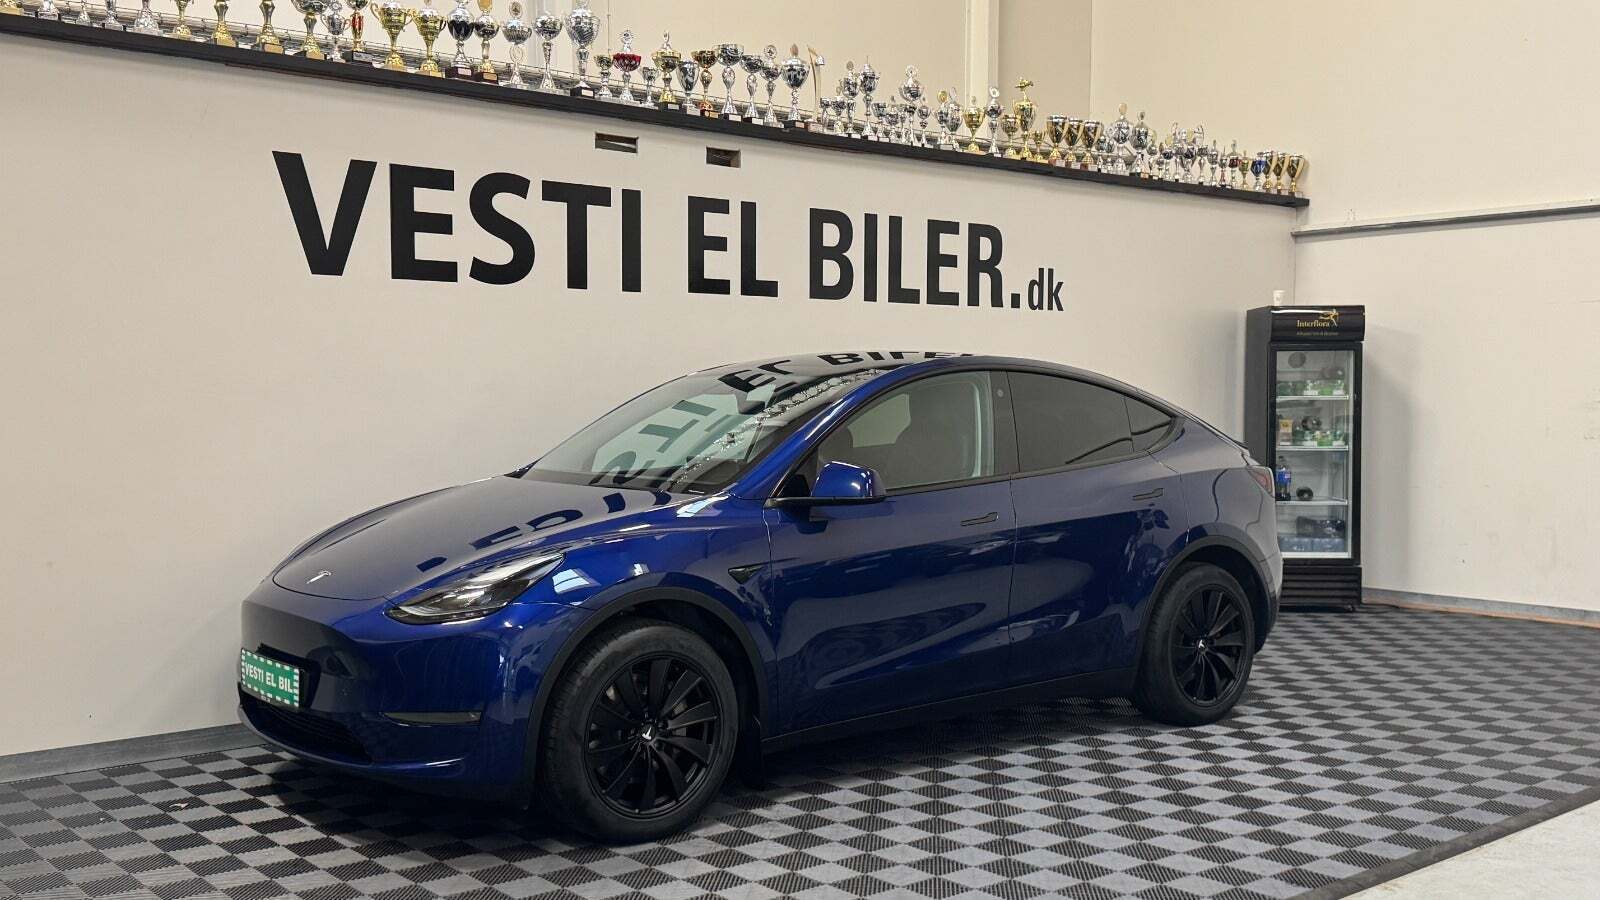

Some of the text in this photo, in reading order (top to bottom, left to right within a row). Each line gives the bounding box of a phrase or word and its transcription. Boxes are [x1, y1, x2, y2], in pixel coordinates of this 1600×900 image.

[272, 151, 641, 292] VESTI
[688, 196, 778, 297] EL
[1297, 319, 1330, 328] Interflora
[244, 662, 264, 683] VESTI
[265, 671, 277, 688] EL
